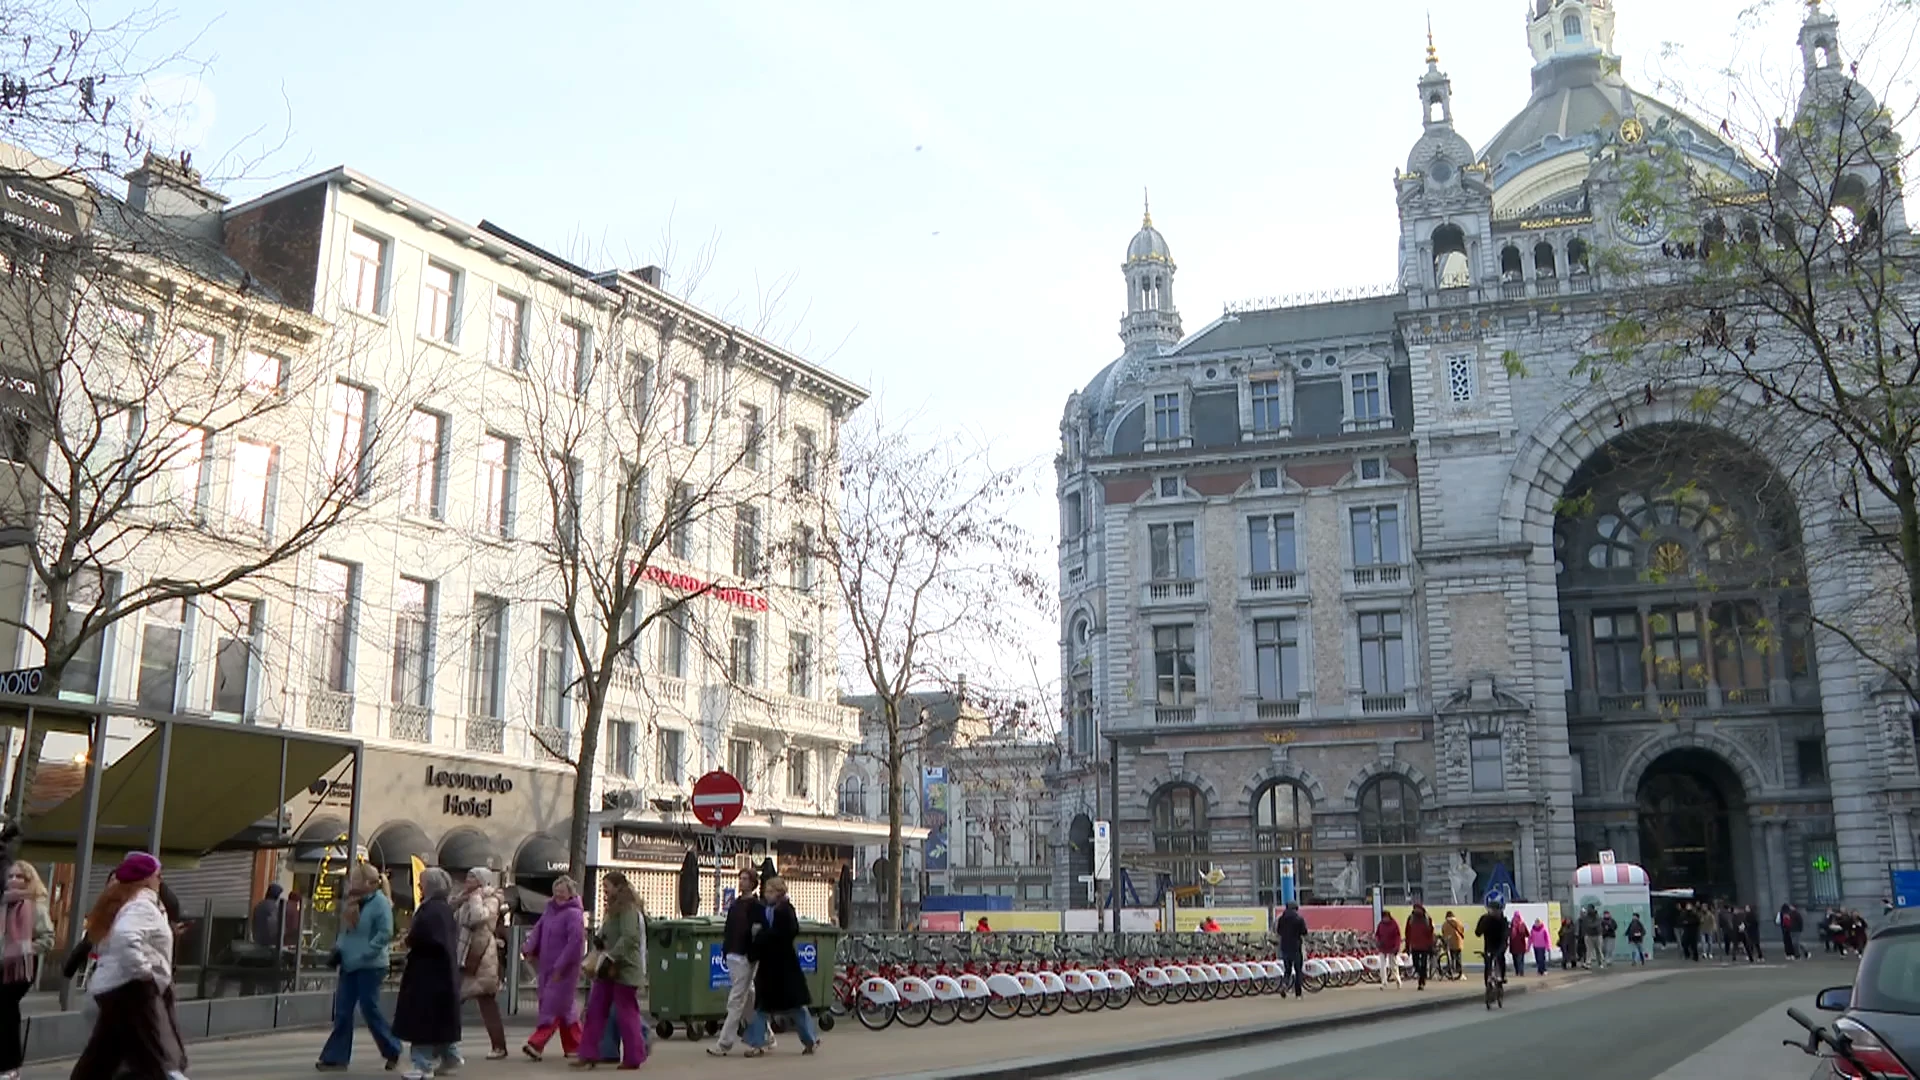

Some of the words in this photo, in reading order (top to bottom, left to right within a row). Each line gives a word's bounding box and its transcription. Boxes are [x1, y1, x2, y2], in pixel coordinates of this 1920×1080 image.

[425, 764, 513, 794] Leonardo
[443, 793, 492, 818] Hotel
[697, 855, 734, 868] DIAMNDS
